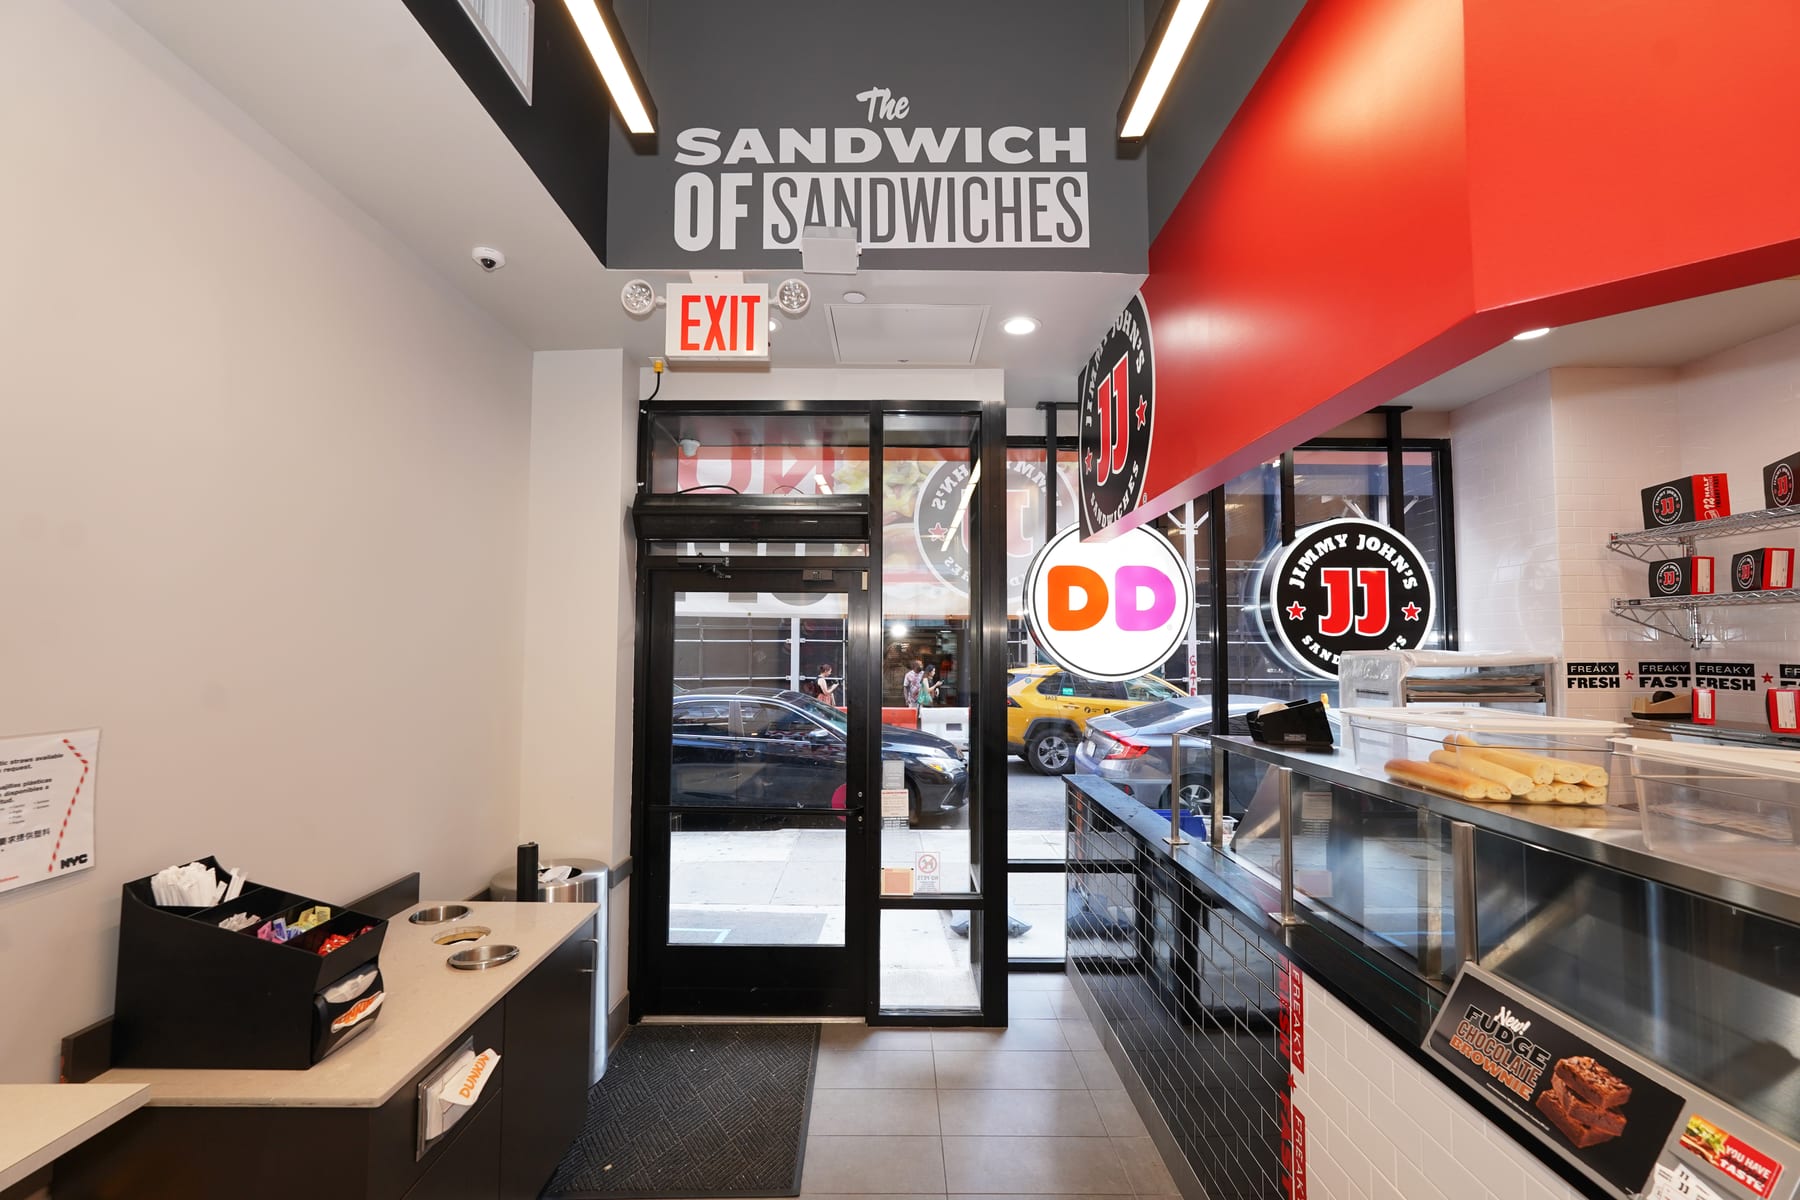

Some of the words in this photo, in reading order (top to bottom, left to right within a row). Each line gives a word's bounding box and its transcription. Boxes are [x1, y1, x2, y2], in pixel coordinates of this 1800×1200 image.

[856, 86, 910, 122] The
[674, 126, 1087, 166] SANDWICH
[674, 172, 753, 252] OF
[771, 176, 1084, 244] SANDWICHES
[680, 295, 761, 352] EXIT
[1097, 350, 1129, 487] JJ
[1289, 533, 1349, 590] JIMMY
[1356, 534, 1418, 590] JOHN'S
[1318, 567, 1390, 637] JJ
[1567, 677, 1620, 689] FRESH
[1570, 665, 1616, 673] FREAKY
[1639, 676, 1691, 688] FAST
[1642, 664, 1688, 672] FREAKY
[1696, 677, 1756, 691] FRESH
[1699, 665, 1752, 675] FREAKY
[60, 853, 88, 869] NYC
[1293, 968, 1302, 1064] FREAKY
[1494, 1006, 1531, 1035] New!
[1456, 1020, 1544, 1088] CHOCOLATE
[1464, 1004, 1551, 1071] FUDGE
[1449, 1034, 1534, 1101] BROWNIE
[1295, 1114, 1304, 1200] FREAK
[1719, 1158, 1766, 1193] TASTE
[1725, 1145, 1745, 1163] YOU
[1744, 1158, 1771, 1179] HAVE
